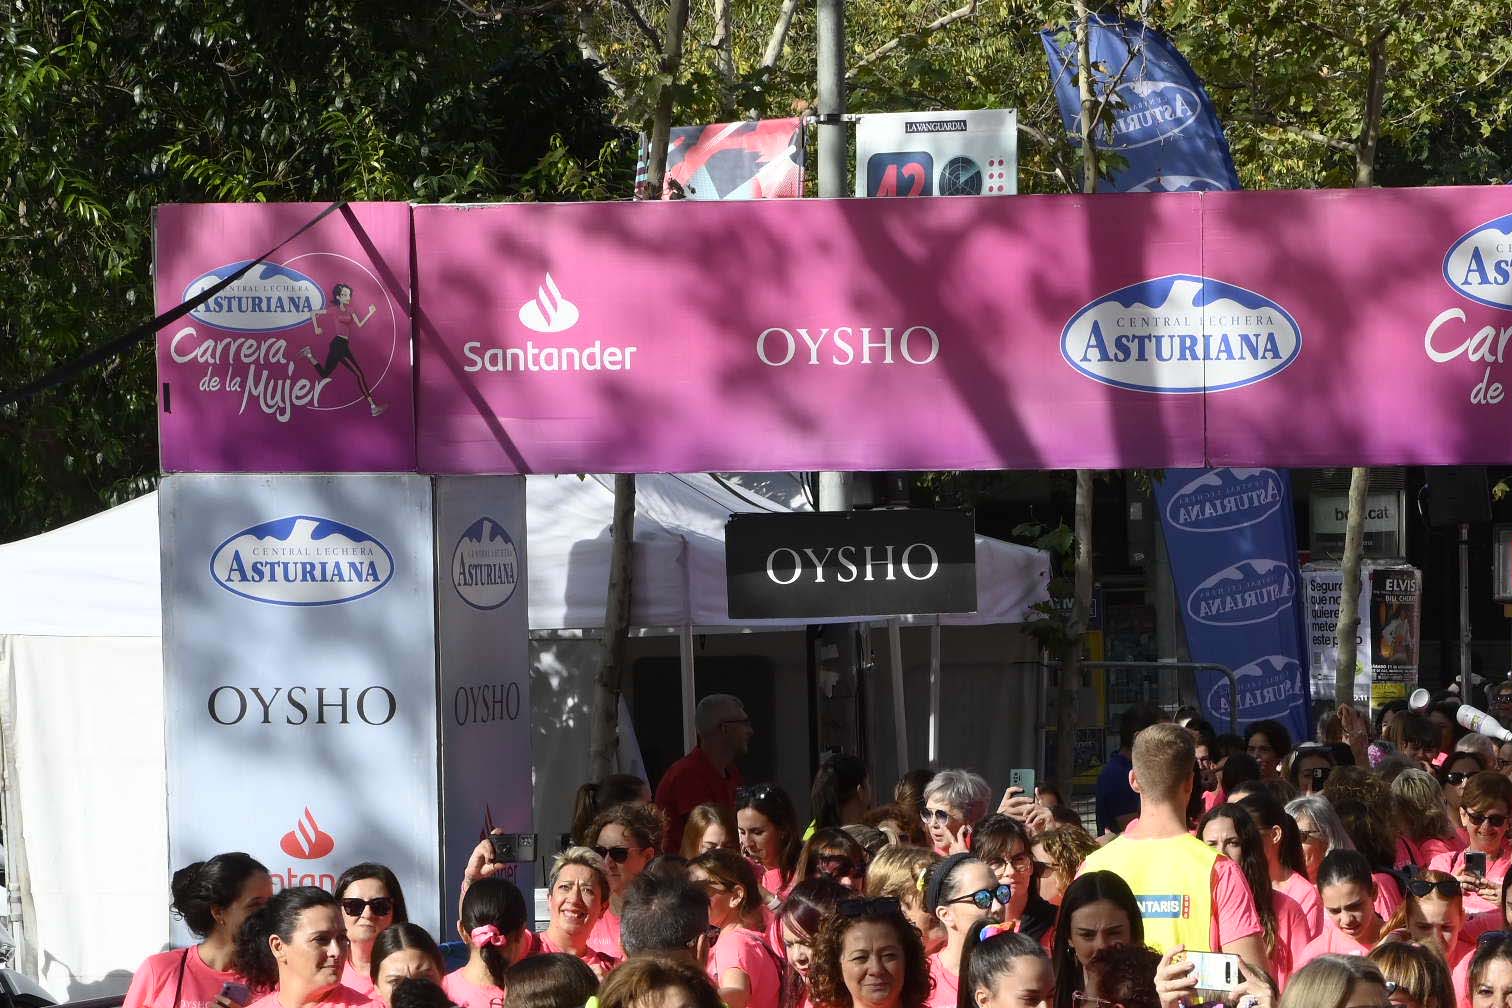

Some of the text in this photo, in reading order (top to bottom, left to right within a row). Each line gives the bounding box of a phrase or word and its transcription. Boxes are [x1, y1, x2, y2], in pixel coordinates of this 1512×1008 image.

[1116, 314, 1275, 329] CENTRAL LECHERA
[170, 327, 287, 364] Carrera
[464, 340, 636, 373] Santander
[756, 326, 940, 367] OYSHO
[1080, 320, 1283, 363] ASTURIANA
[199, 360, 332, 422] de la Mujer
[1470, 366, 1504, 404] de
[225, 549, 380, 583] ASTURIANA
[252, 547, 374, 556] CENTRAL LECHERA
[457, 551, 515, 587] ASTURIANA
[766, 543, 939, 585] OYSHO
[1385, 580, 1416, 592] ELVIS
[208, 685, 397, 726] OYSHO
[454, 682, 520, 726] OYSHO
